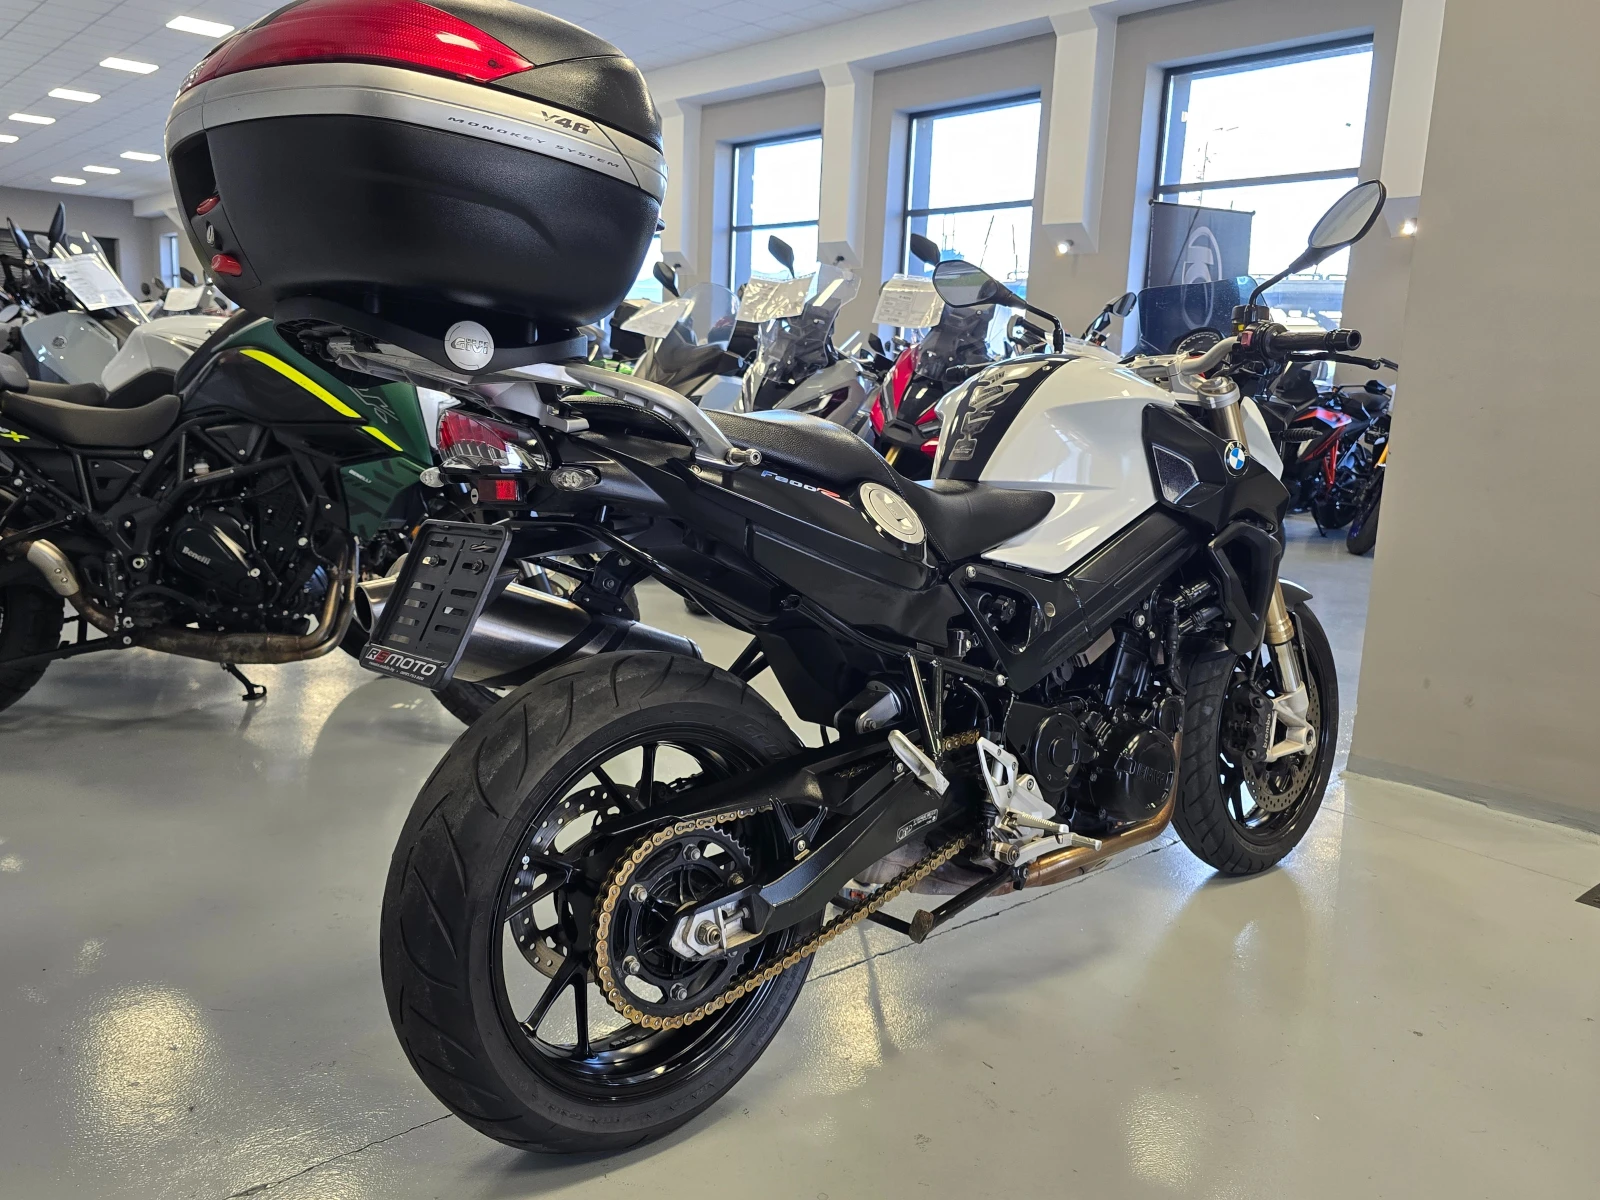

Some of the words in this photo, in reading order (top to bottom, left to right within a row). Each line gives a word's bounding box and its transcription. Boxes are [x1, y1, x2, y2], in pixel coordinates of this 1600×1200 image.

[541, 110, 592, 135] V46
[448, 116, 547, 144] MONOKEY
[555, 144, 620, 168] SYSTEM
[450, 337, 489, 355] GIVI
[181, 545, 212, 566] Benelli
[1262, 713, 1271, 749] brembo
